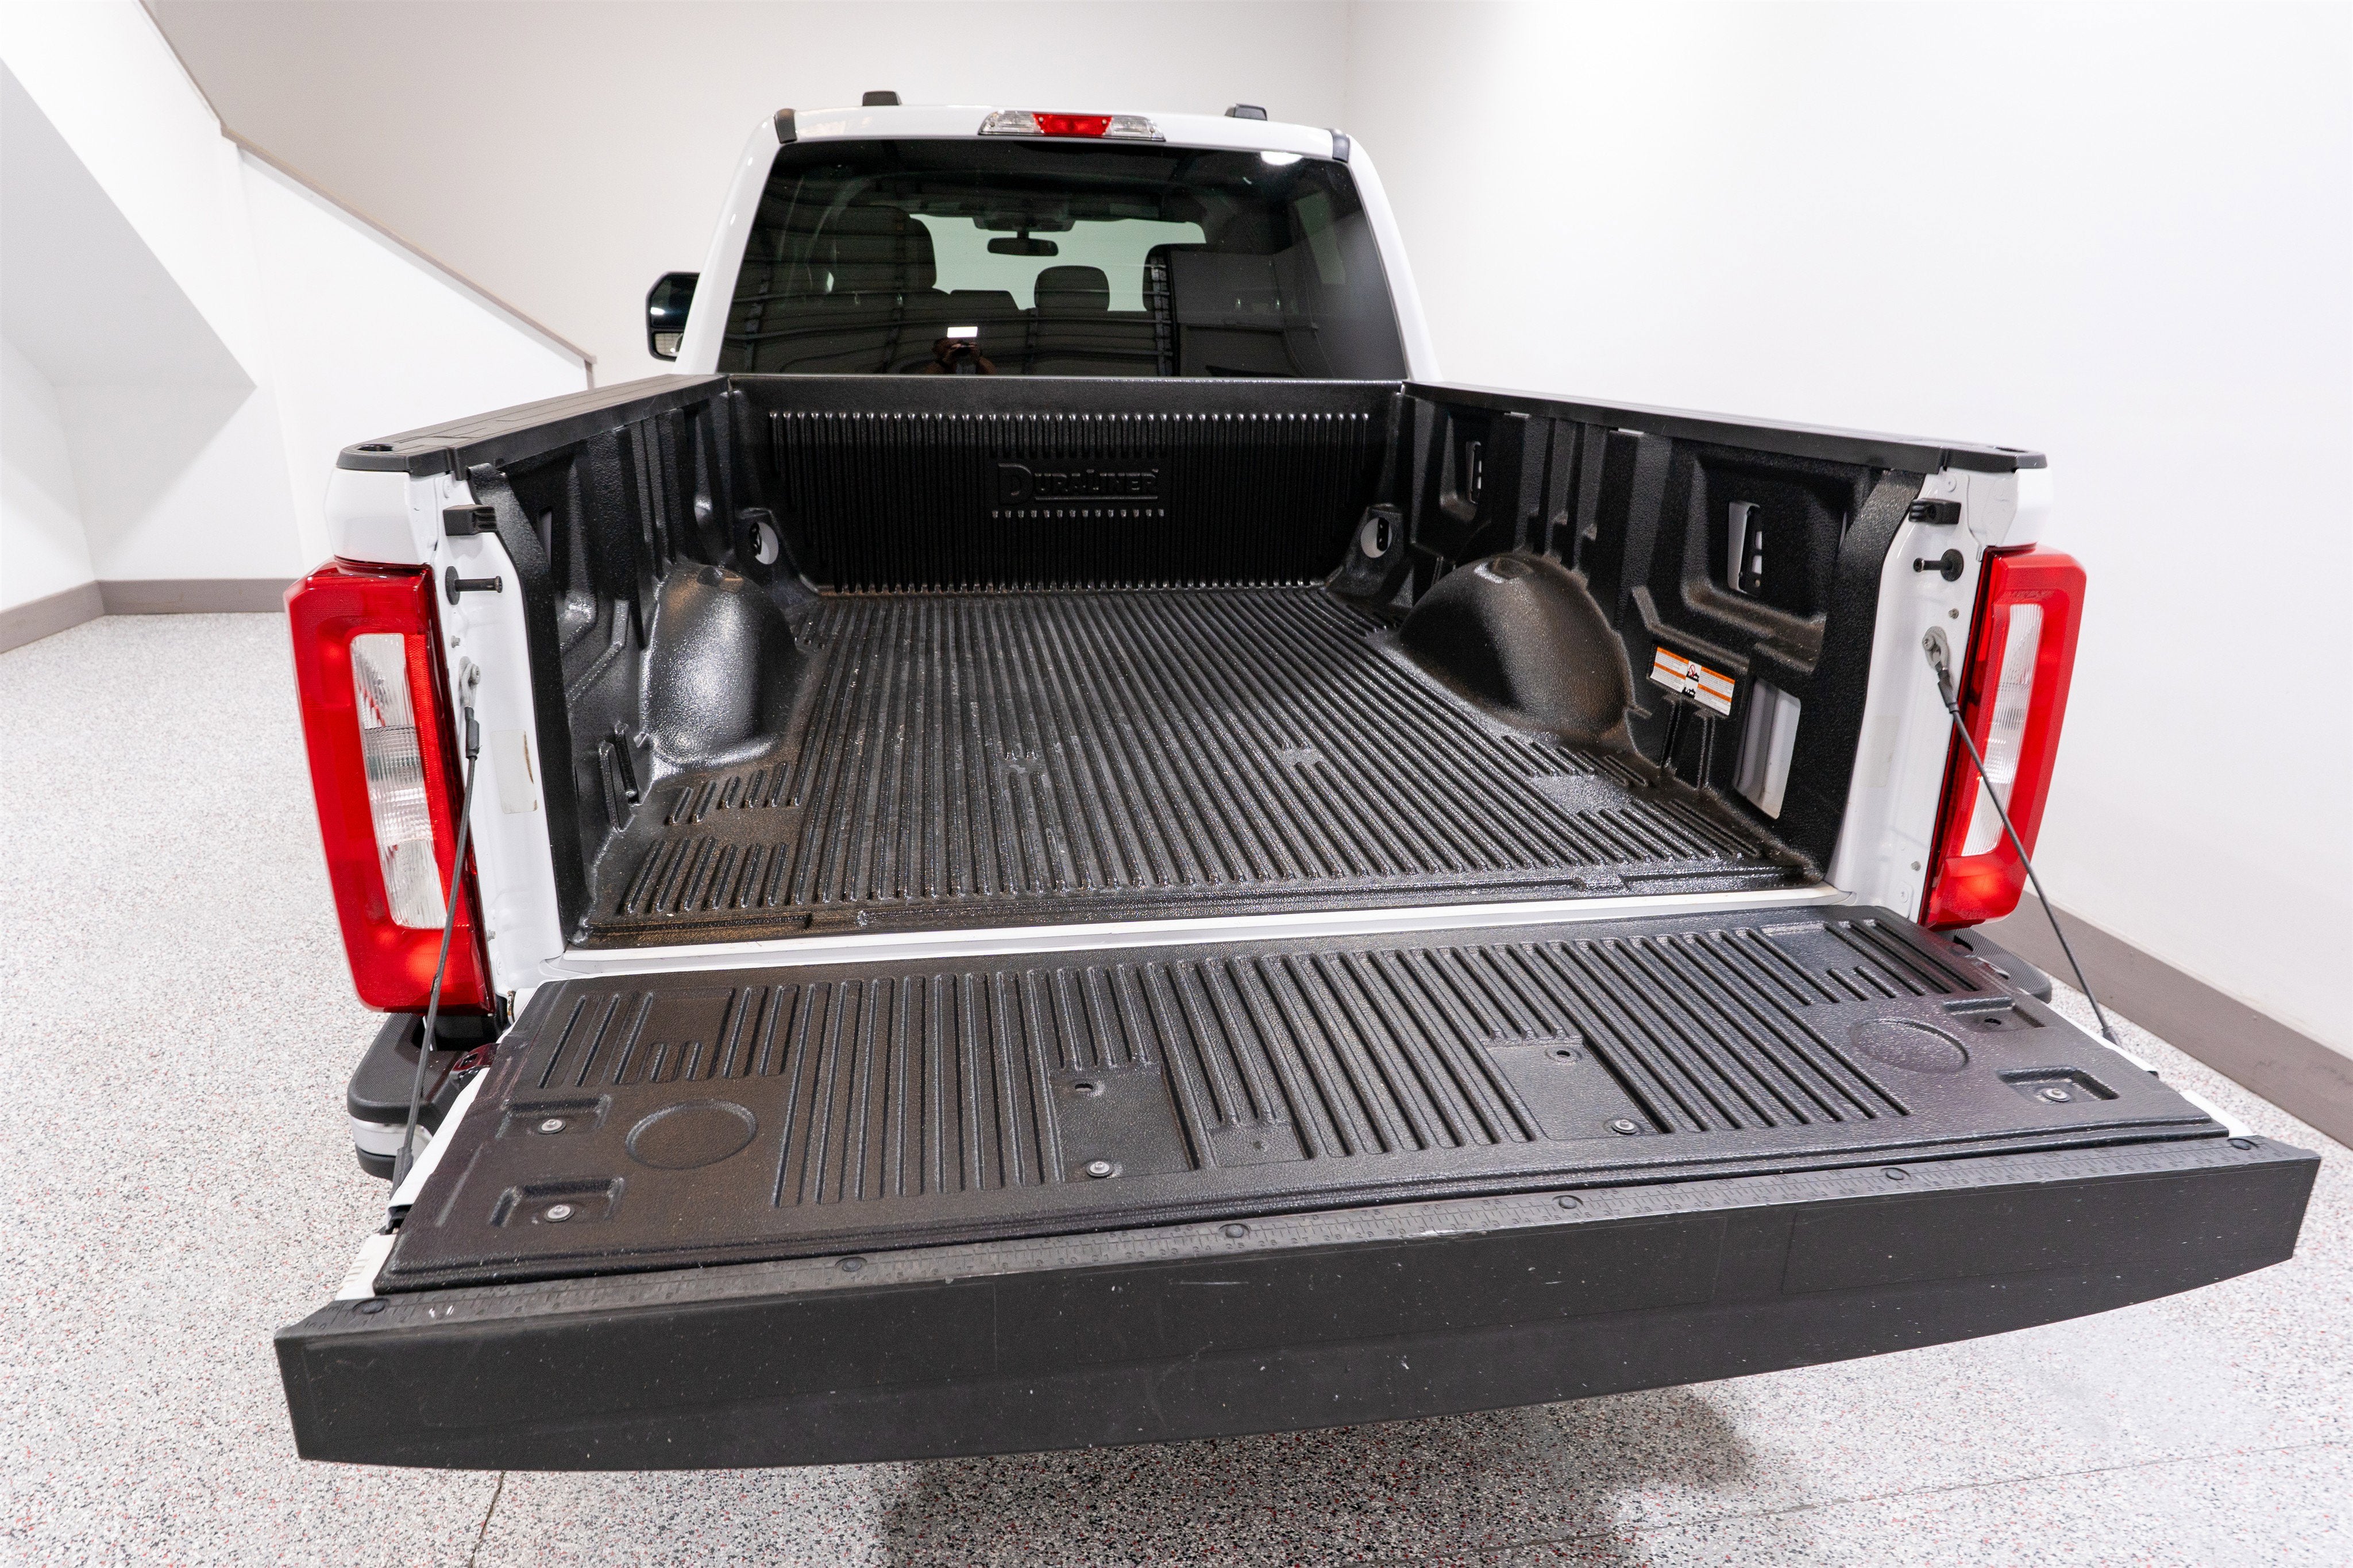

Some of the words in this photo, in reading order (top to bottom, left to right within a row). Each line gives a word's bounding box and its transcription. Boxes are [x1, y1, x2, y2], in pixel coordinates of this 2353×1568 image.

[1225, 1241, 1245, 1250] 25
[1290, 1235, 1309, 1245] 27
[1386, 1227, 1406, 1236] 30
[1480, 1219, 1501, 1228] 33
[1541, 1214, 1563, 1222] 35
[1602, 1208, 1621, 1216] 37
